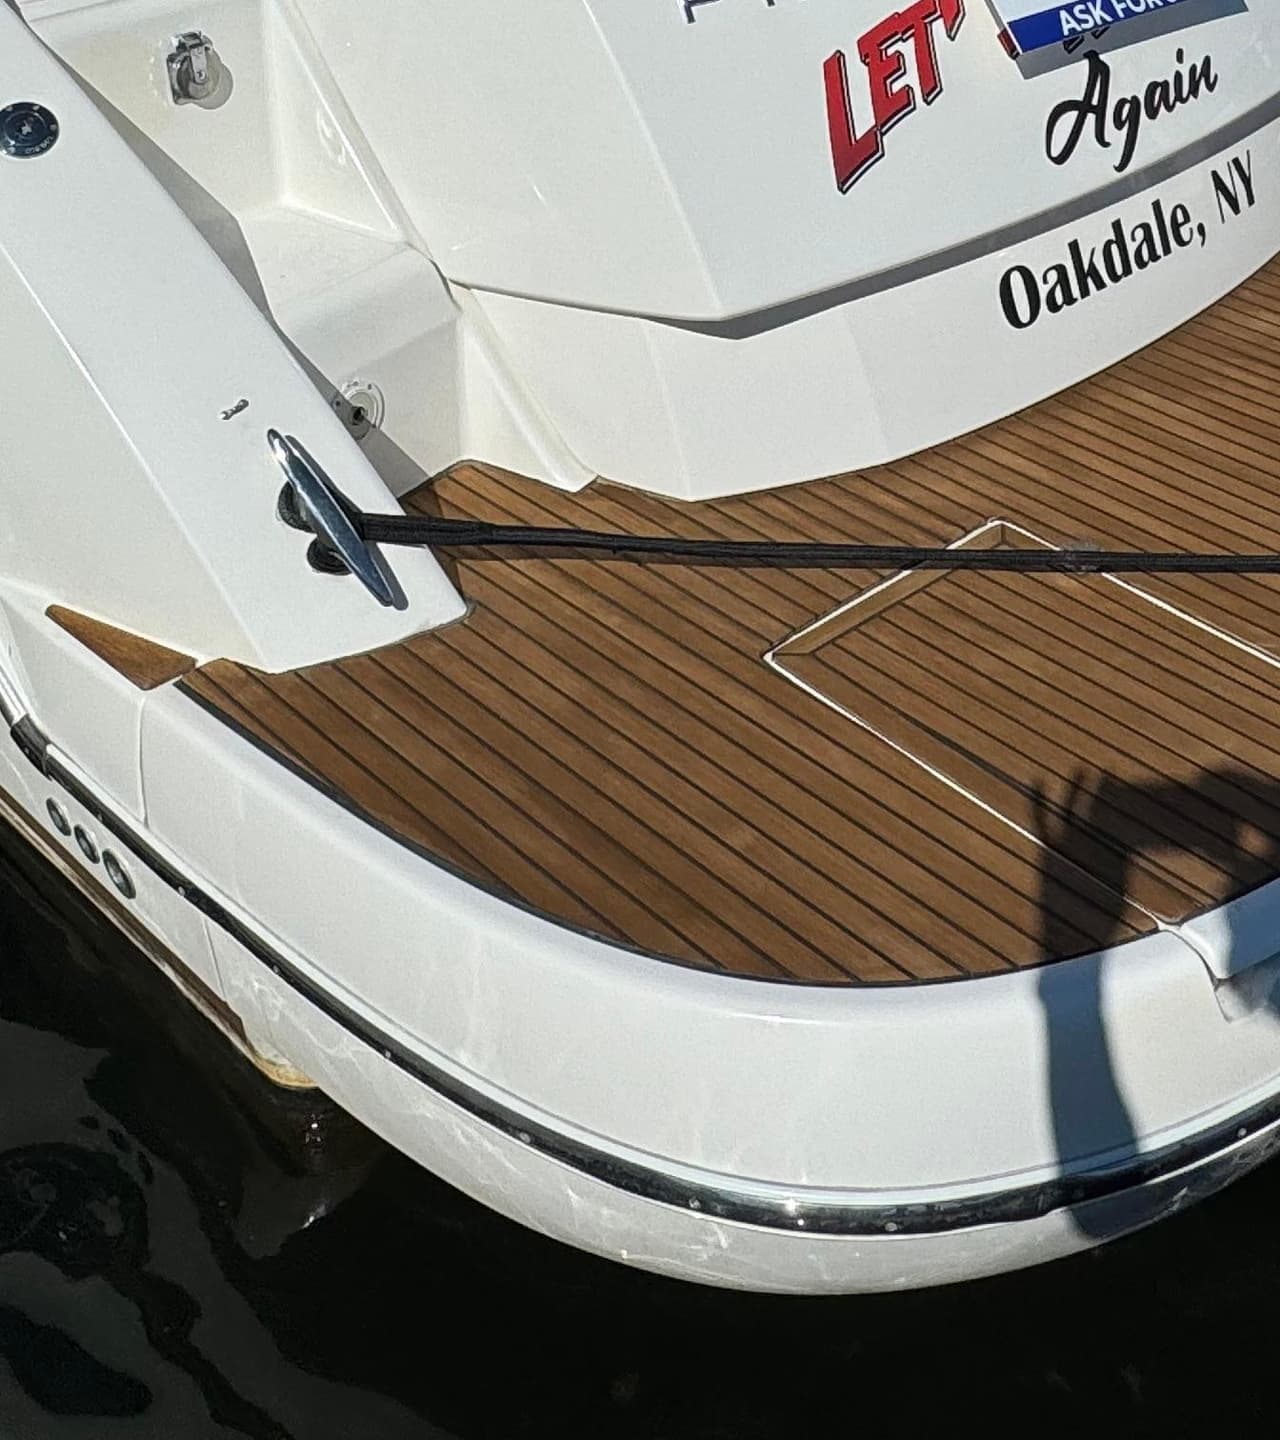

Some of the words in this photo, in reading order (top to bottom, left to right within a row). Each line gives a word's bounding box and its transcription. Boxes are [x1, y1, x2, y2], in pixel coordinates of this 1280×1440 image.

[1058, 2, 1114, 36] ASK
[1045, 47, 1218, 173] Again
[998, 198, 1207, 329] Oakdale,
[1210, 149, 1256, 224] NY
